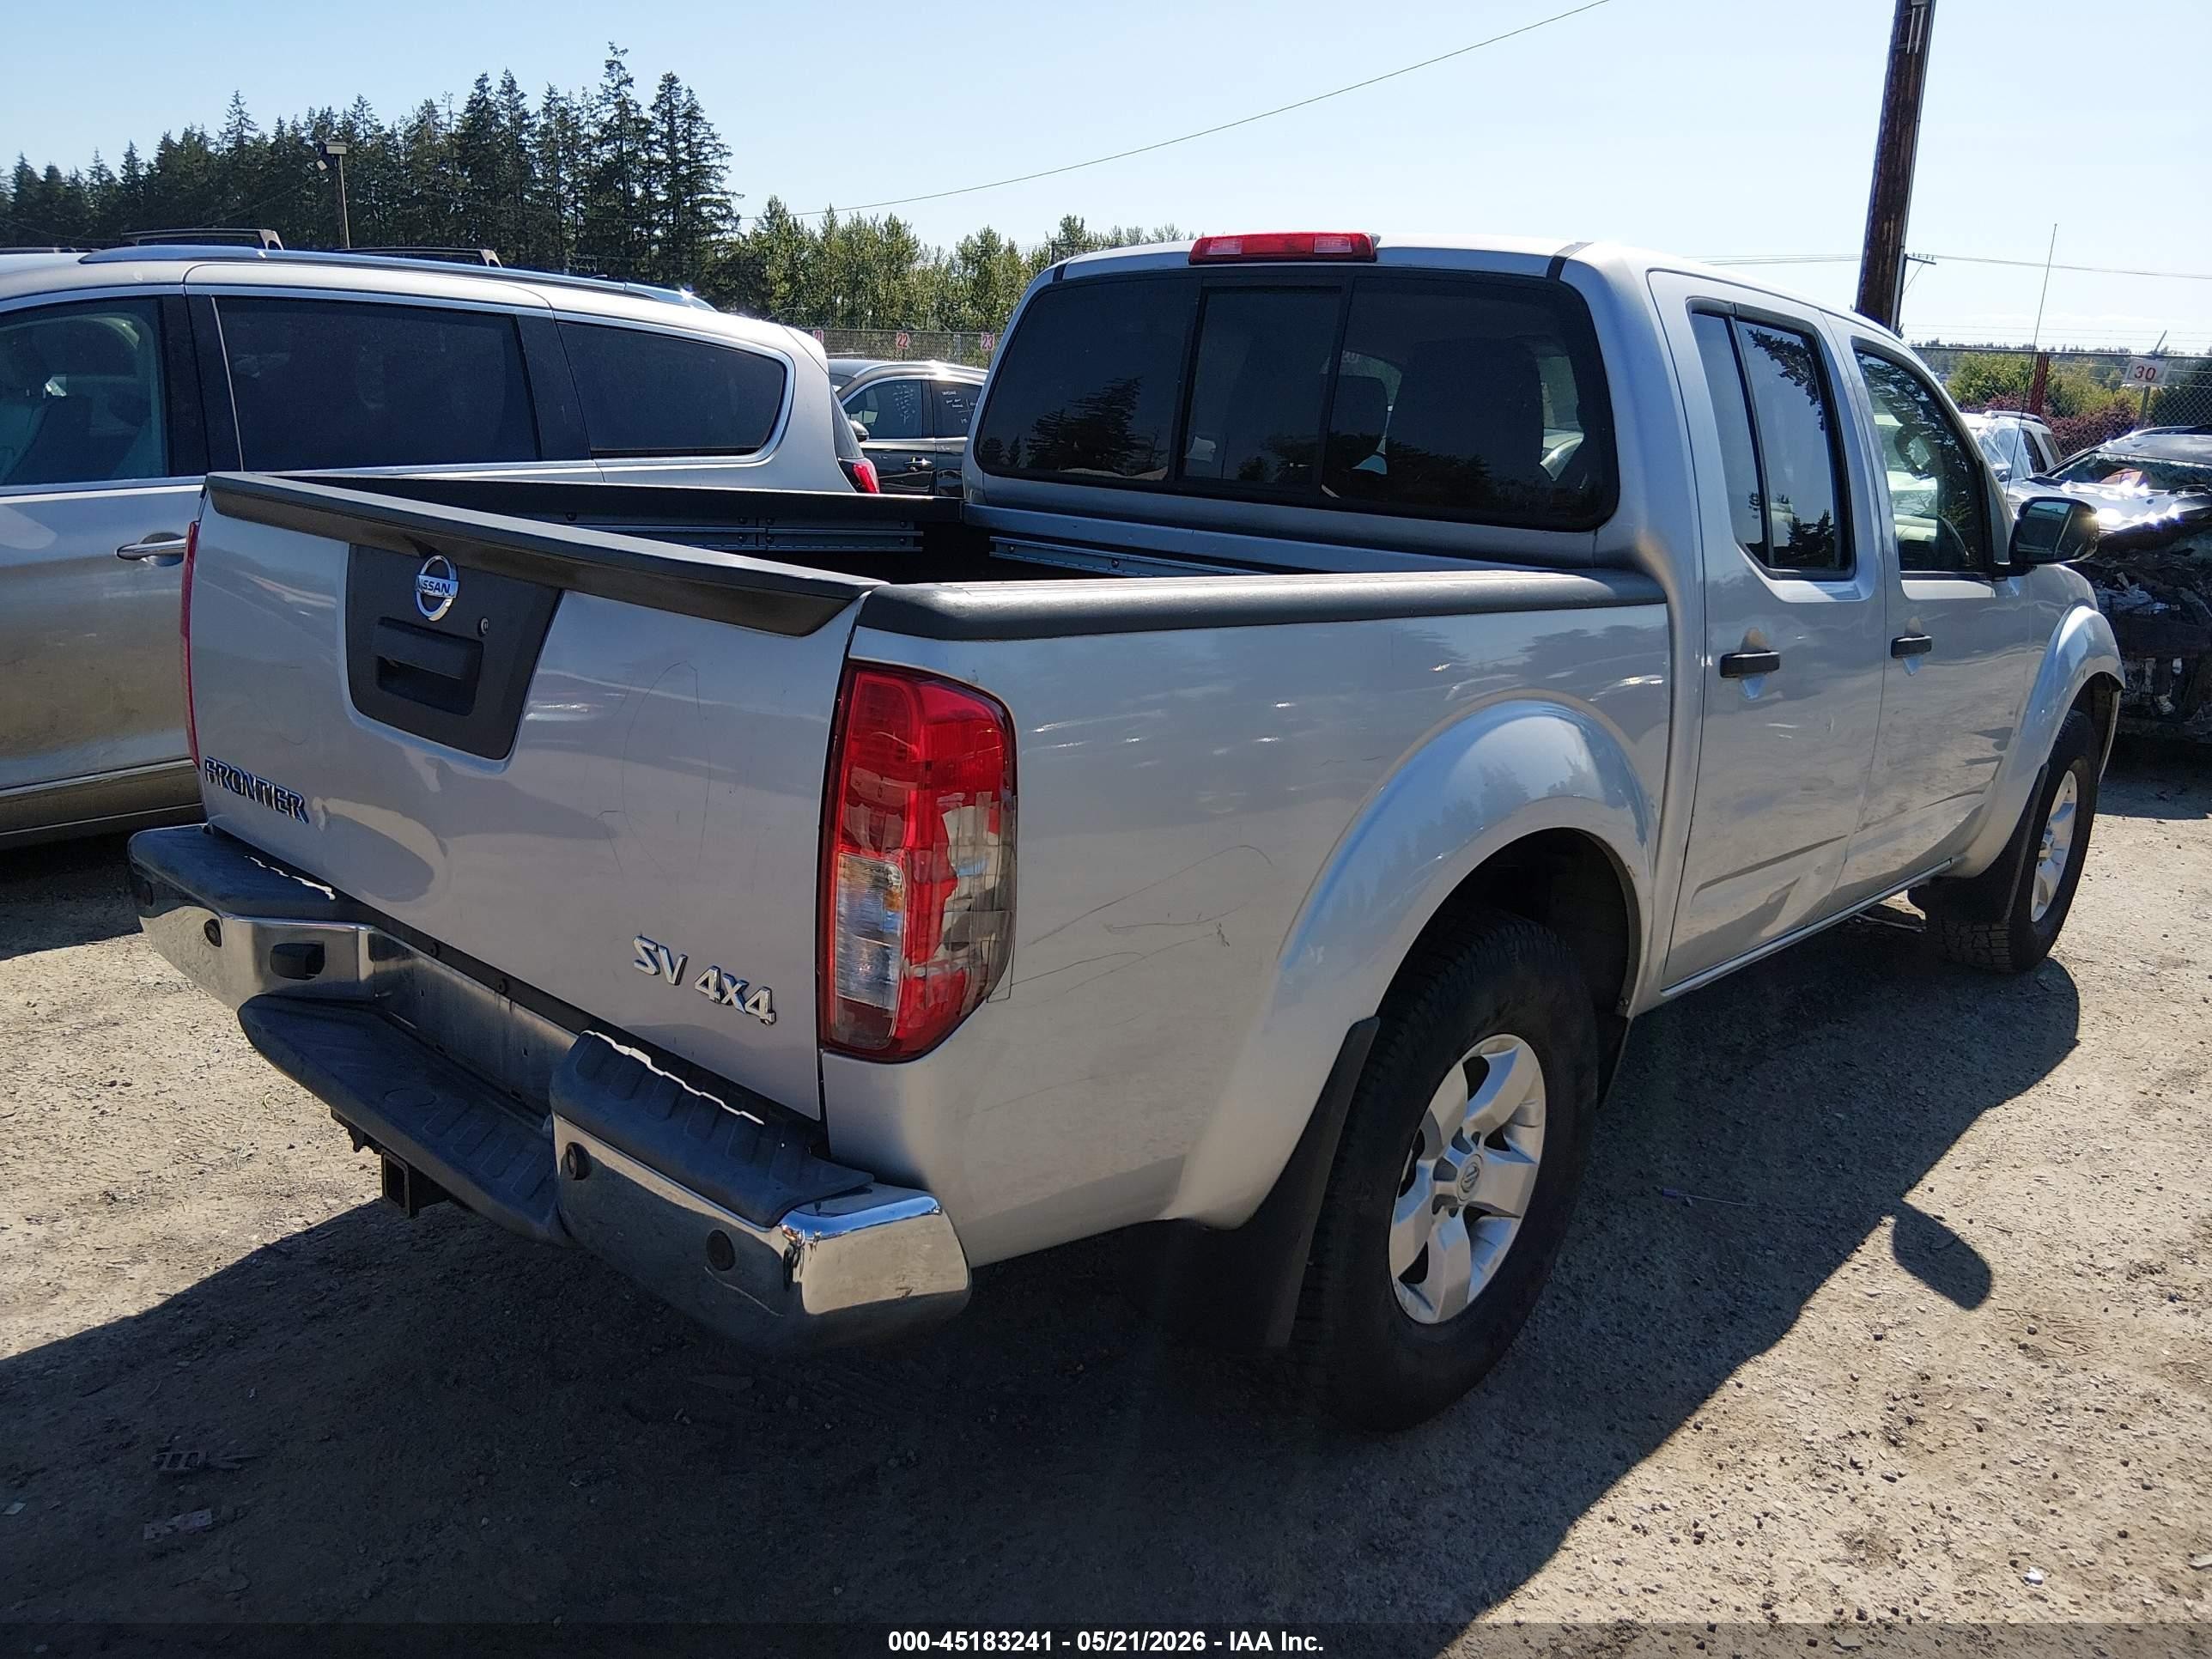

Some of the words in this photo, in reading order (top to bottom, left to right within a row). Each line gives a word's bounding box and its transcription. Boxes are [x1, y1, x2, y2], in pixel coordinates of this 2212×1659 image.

[897, 333, 908, 348] 22
[981, 335, 994, 350] 23
[2134, 365, 2156, 380] 30
[418, 577, 451, 593] ISSAN
[204, 756, 309, 824] FRONTIER
[633, 935, 688, 987] SV
